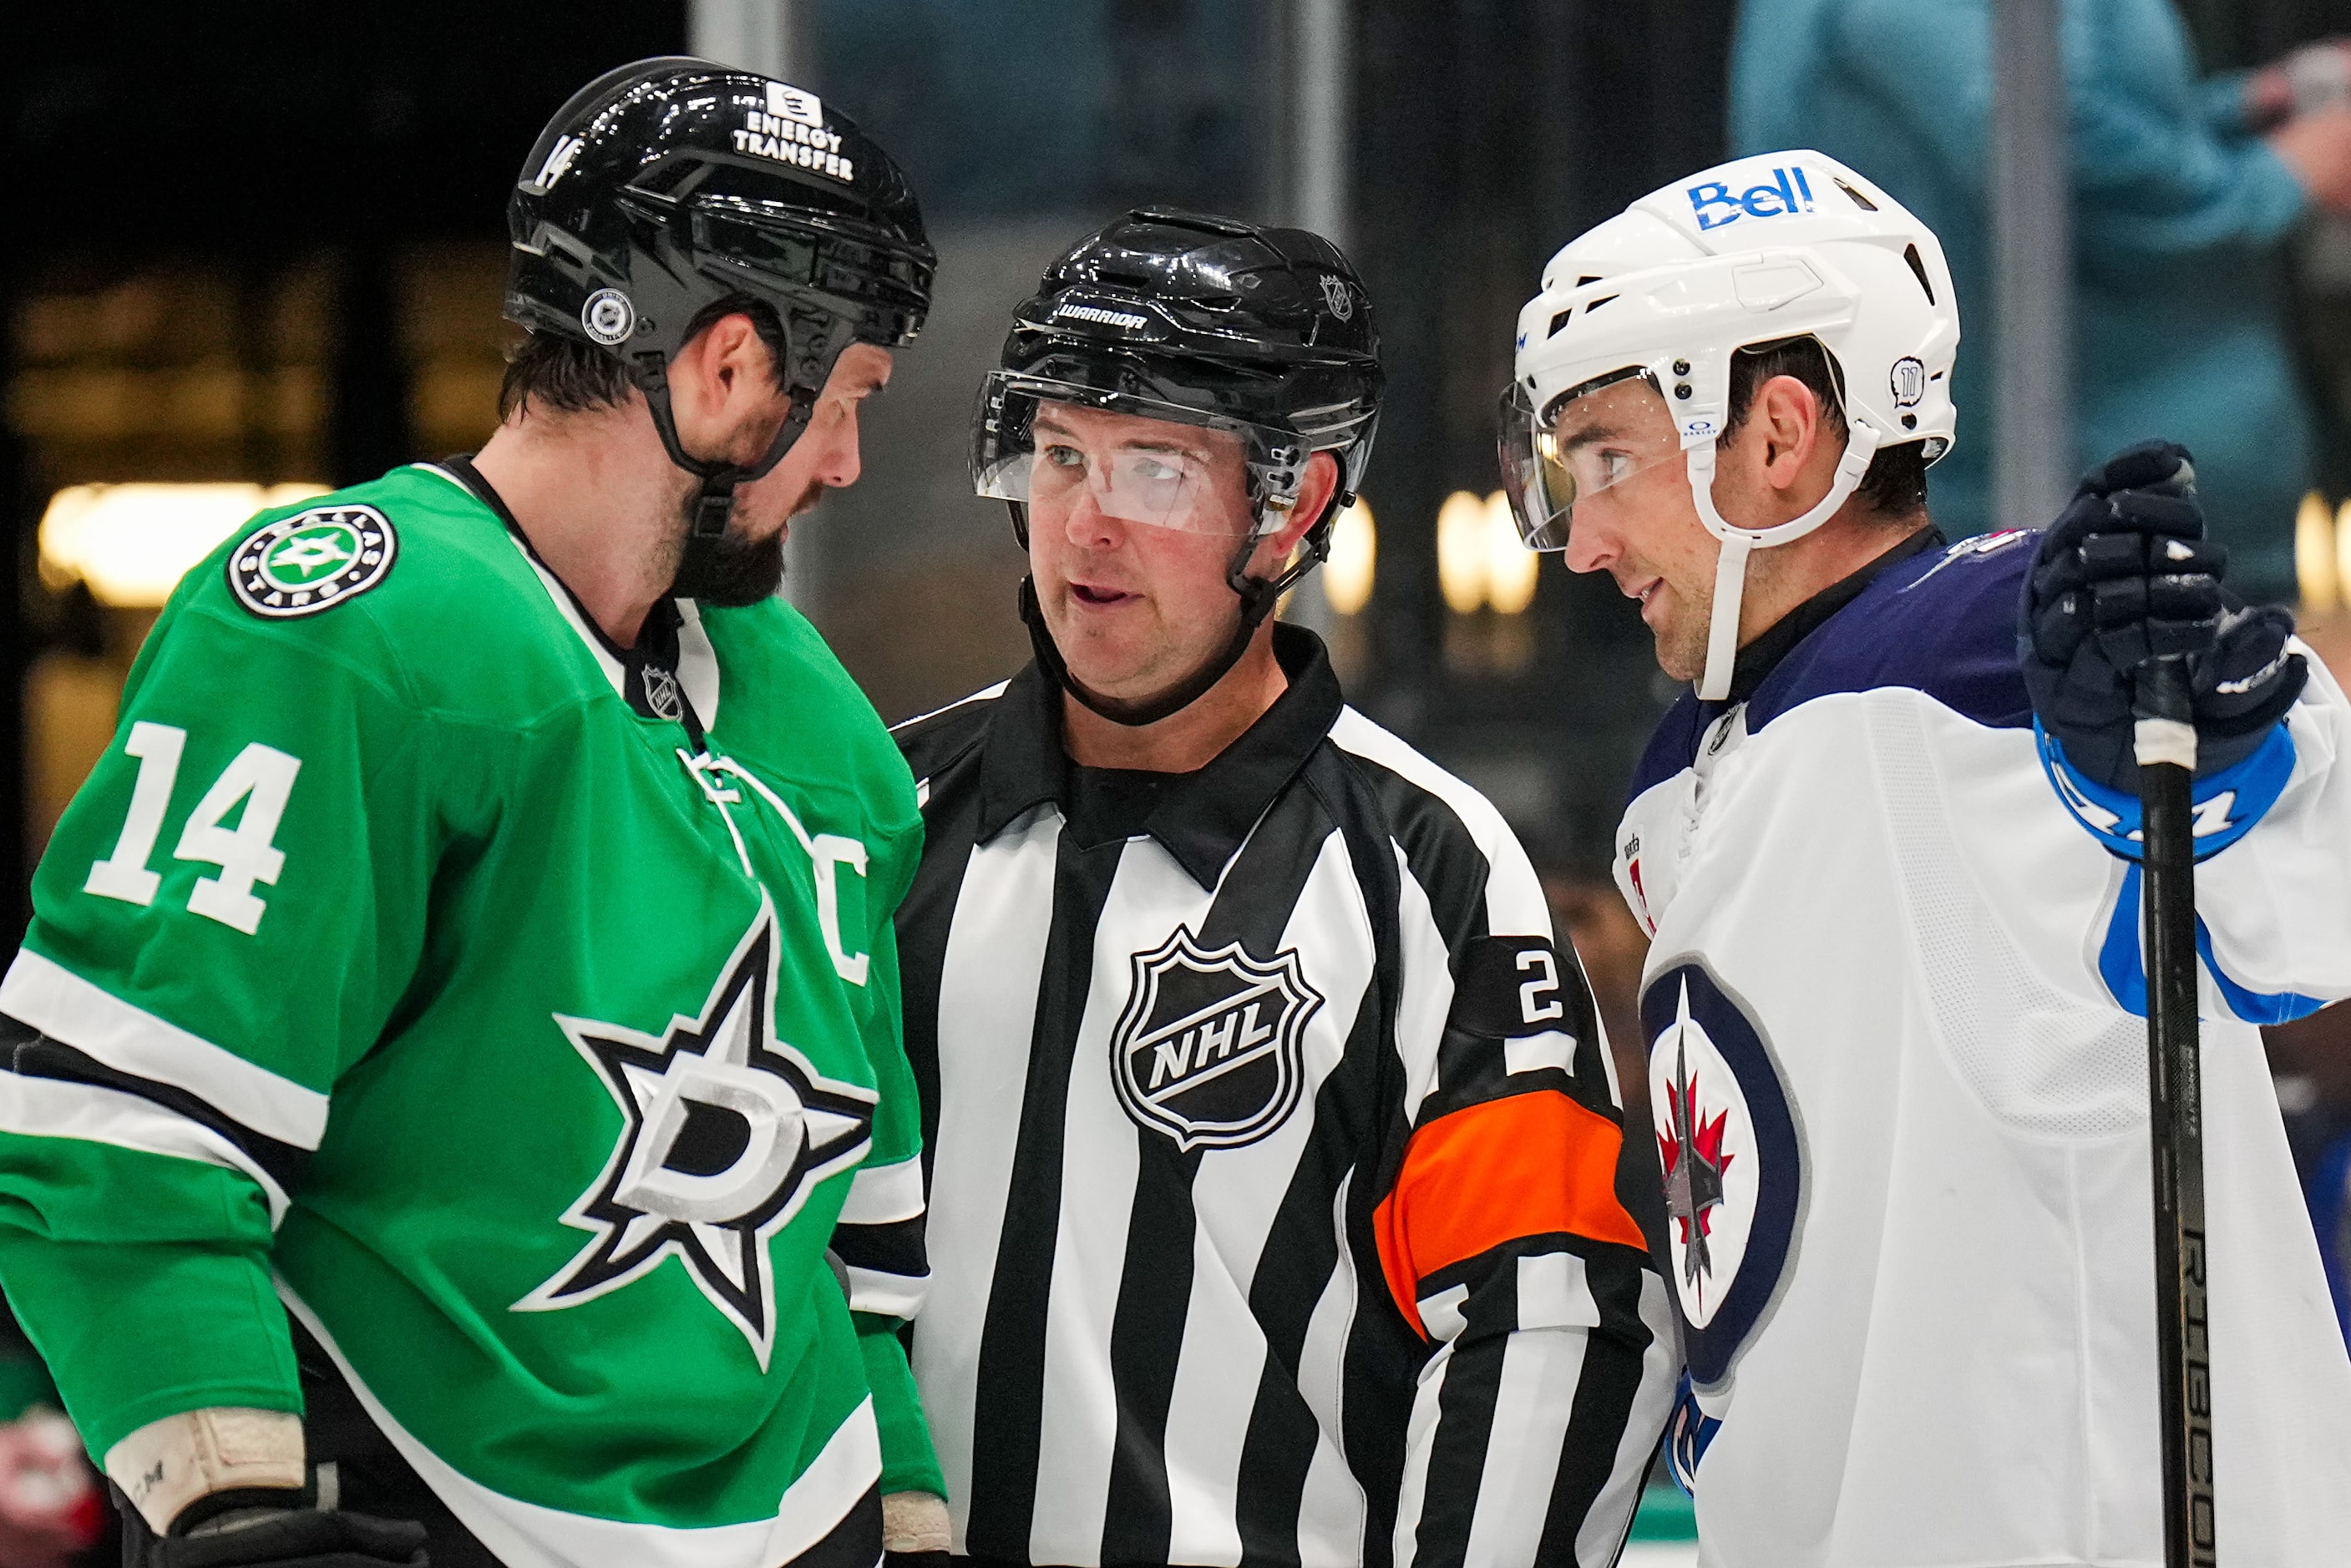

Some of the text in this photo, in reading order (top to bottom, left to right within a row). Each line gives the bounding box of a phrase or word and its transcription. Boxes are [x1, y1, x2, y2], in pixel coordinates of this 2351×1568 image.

[732, 129, 854, 182] TRANSFER
[747, 110, 843, 154] ENERGY
[1687, 166, 1815, 231] Bell
[1057, 303, 1148, 330] WARRIOR
[239, 554, 341, 608] STARS
[83, 721, 302, 936] 14
[812, 833, 869, 988] C
[1515, 949, 1564, 1024] 2
[1148, 1002, 1273, 1090] NHL
[2183, 1227, 2216, 1568] RIBCO
